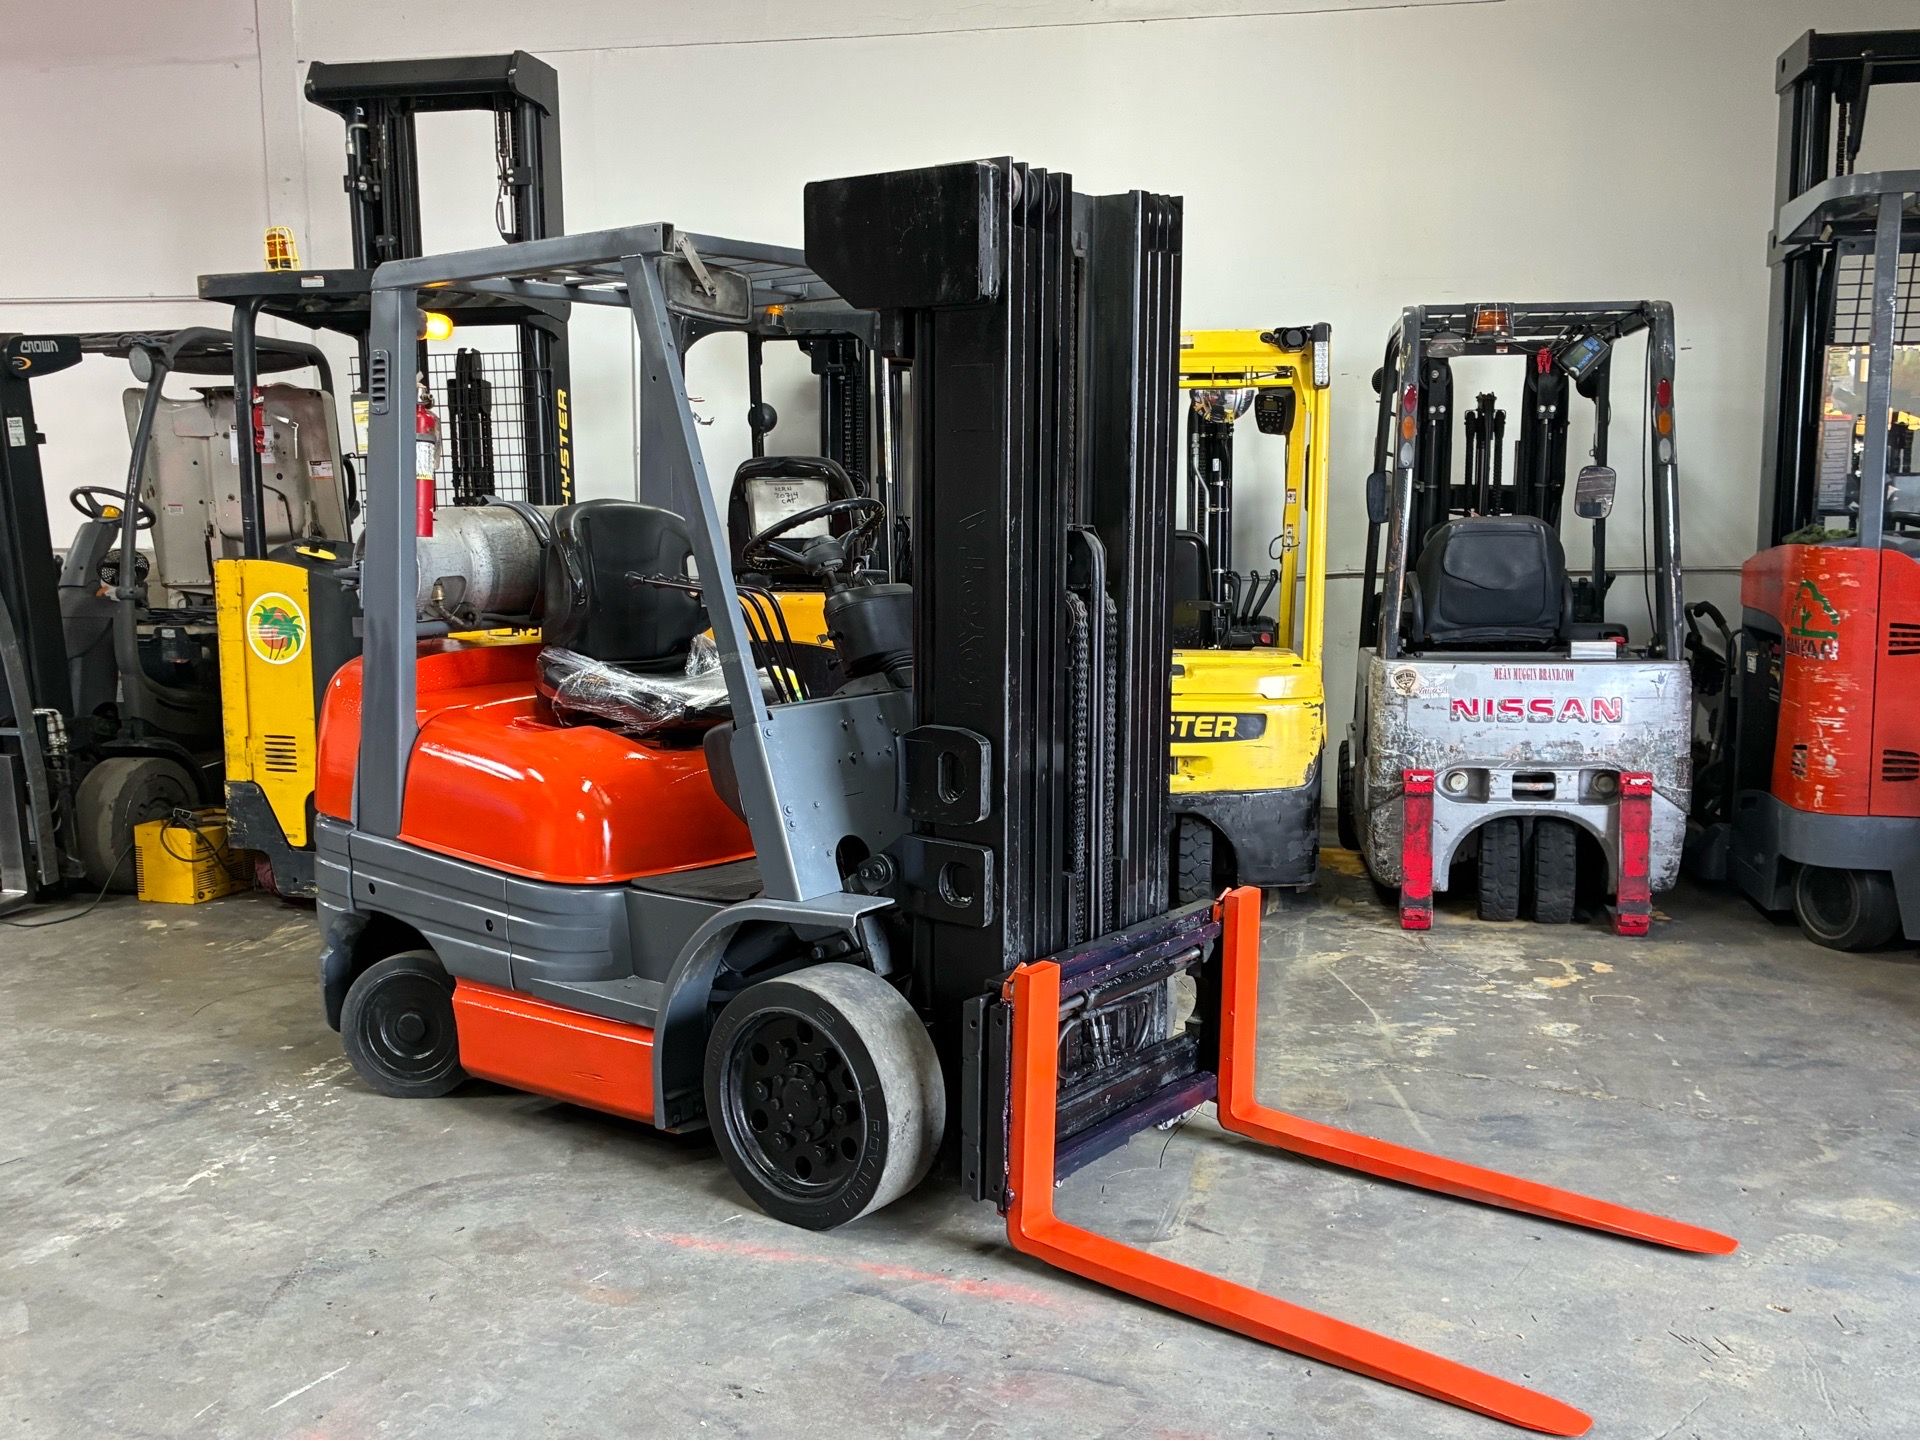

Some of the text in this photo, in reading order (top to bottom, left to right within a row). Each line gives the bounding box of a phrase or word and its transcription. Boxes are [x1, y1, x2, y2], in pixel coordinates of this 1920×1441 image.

[20, 340, 59, 353] CROWN
[1493, 667, 1511, 680] MEAN
[1513, 667, 1537, 680] MUGGIN
[1450, 697, 1623, 723] NISSAN
[1170, 715, 1238, 738] TER
